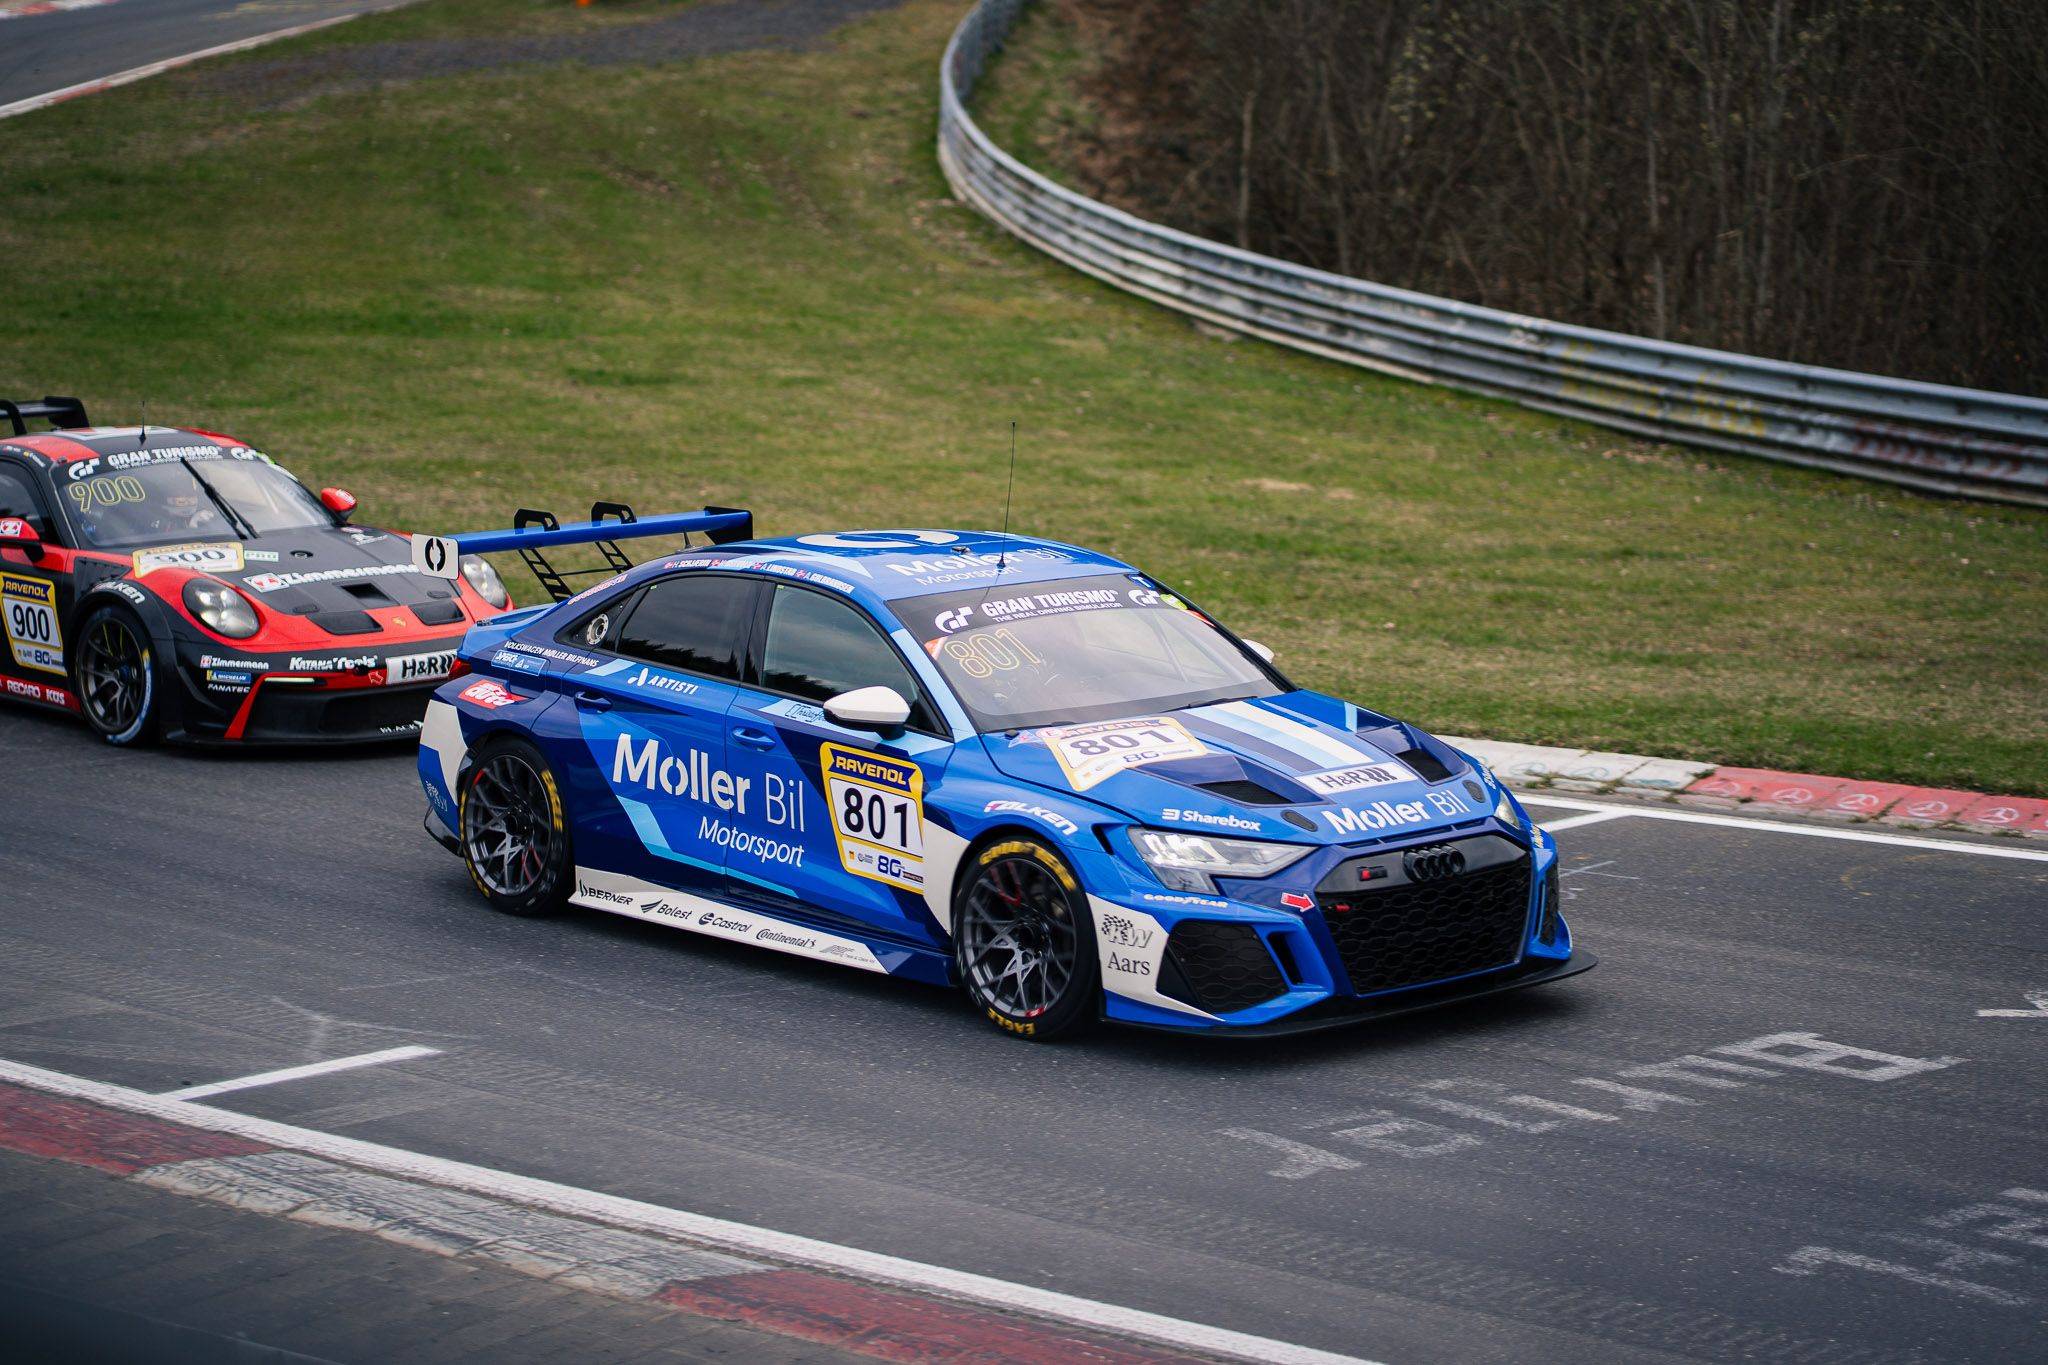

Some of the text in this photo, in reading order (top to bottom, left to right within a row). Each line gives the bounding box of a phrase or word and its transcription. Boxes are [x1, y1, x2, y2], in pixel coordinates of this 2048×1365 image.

[107, 450, 151, 467] GRAN
[151, 445, 222, 461] TURISMO
[68, 475, 146, 512] 900
[1019, 547, 1074, 561] Bil
[278, 564, 420, 585] Zimmermann
[914, 565, 1022, 586] Motorsport
[5, 580, 46, 597] RAVENOL
[982, 589, 1118, 618] GRAN TURISMO
[993, 601, 1124, 624] THE REAL DRIVING SIMULATOR
[12, 604, 50, 642] 900
[504, 640, 545, 656] VOLKSWAGEN
[944, 628, 1041, 679] 801
[211, 657, 270, 670] Zimmermann
[401, 658, 438, 680] H&R
[6, 680, 41, 698] RECARO
[207, 683, 251, 694] FANATEC
[647, 675, 699, 695] ARTISTI
[1070, 730, 1175, 756] 801
[836, 756, 907, 785] RAVENOL
[1316, 770, 1371, 788] H&R
[765, 772, 805, 833] Bil
[1425, 789, 1471, 816] Bil
[844, 788, 908, 848] 801
[984, 800, 1079, 836] FALKEN
[1181, 810, 1261, 831] Sharebox
[698, 816, 805, 868] Motorsport
[588, 886, 633, 905] BERNER
[1143, 893, 1229, 908] GOODYEAR
[657, 903, 693, 920] Bolest
[712, 916, 753, 933] Castrol
[756, 928, 810, 949] Continental
[1107, 951, 1151, 976] Aars
